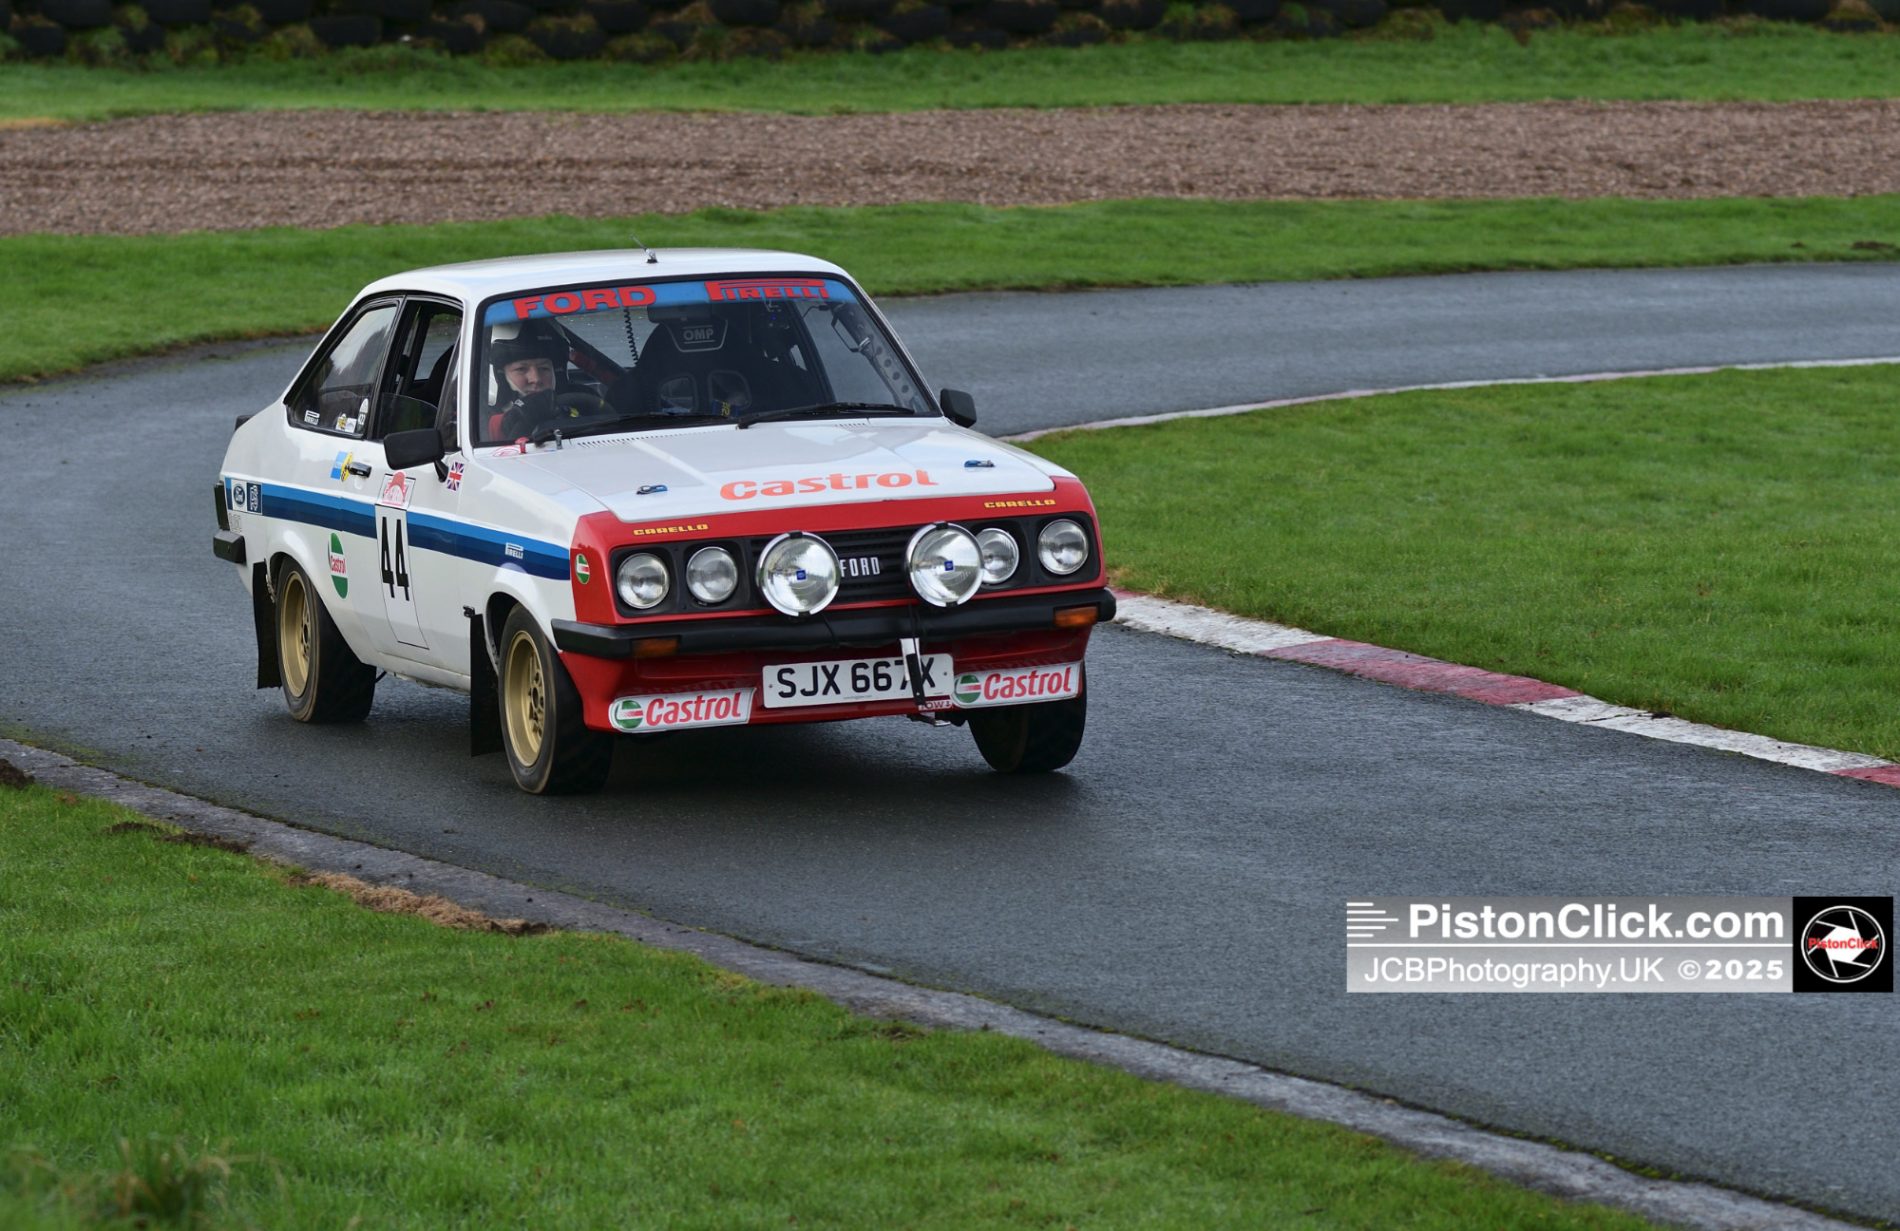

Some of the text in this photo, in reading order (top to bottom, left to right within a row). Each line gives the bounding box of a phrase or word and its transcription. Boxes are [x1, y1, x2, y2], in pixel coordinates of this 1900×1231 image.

[513, 286, 657, 320] FORD
[704, 278, 830, 302] PIRELLI
[683, 328, 714, 341] OMP
[720, 469, 939, 500] Castrol
[983, 499, 1056, 508] CARELLO
[633, 523, 709, 536] CARELLO
[381, 516, 409, 601] 44
[840, 557, 880, 578] FORD
[777, 657, 936, 698] SJX 667X
[985, 666, 1072, 700] Castrol
[645, 692, 742, 726] Castrol
